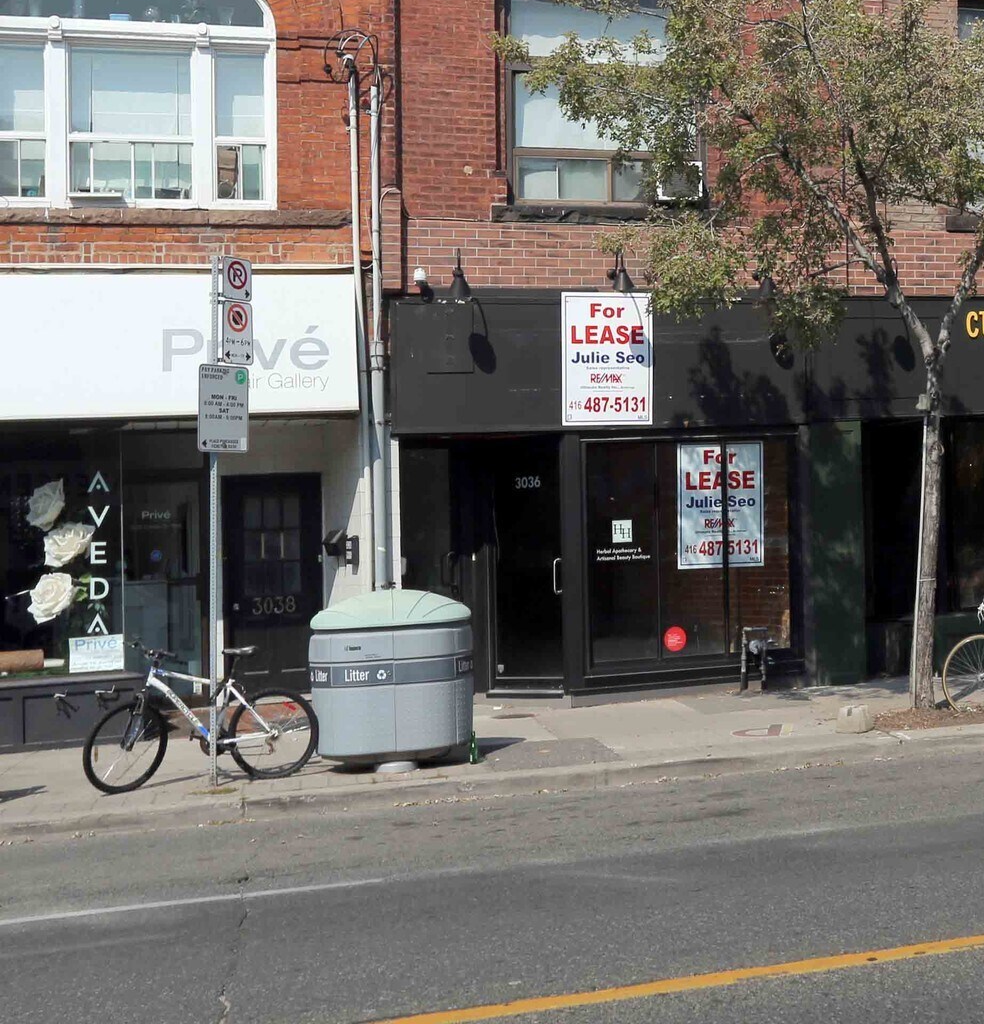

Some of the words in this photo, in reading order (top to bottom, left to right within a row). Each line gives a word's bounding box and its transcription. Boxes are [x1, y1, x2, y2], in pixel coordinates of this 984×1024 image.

[590, 303, 625, 319] For
[570, 325, 645, 345] LEASE
[162, 326, 330, 372] Pvé
[571, 351, 610, 364] Julie
[616, 351, 645, 364] Seo
[267, 372, 330, 391] Gallery
[590, 372, 623, 384] RE/MAX
[569, 400, 582, 410] 416
[583, 396, 646, 413] 487-5131
[514, 476, 541, 490] 3036
[685, 470, 755, 490] LEASE
[685, 496, 722, 509] Julie
[727, 496, 756, 507] Seo
[685, 545, 697, 554] 416
[699, 539, 759, 556] 4875131
[252, 596, 296, 615] 3038
[74, 636, 118, 651] Privé
[344, 669, 370, 682] Litter
